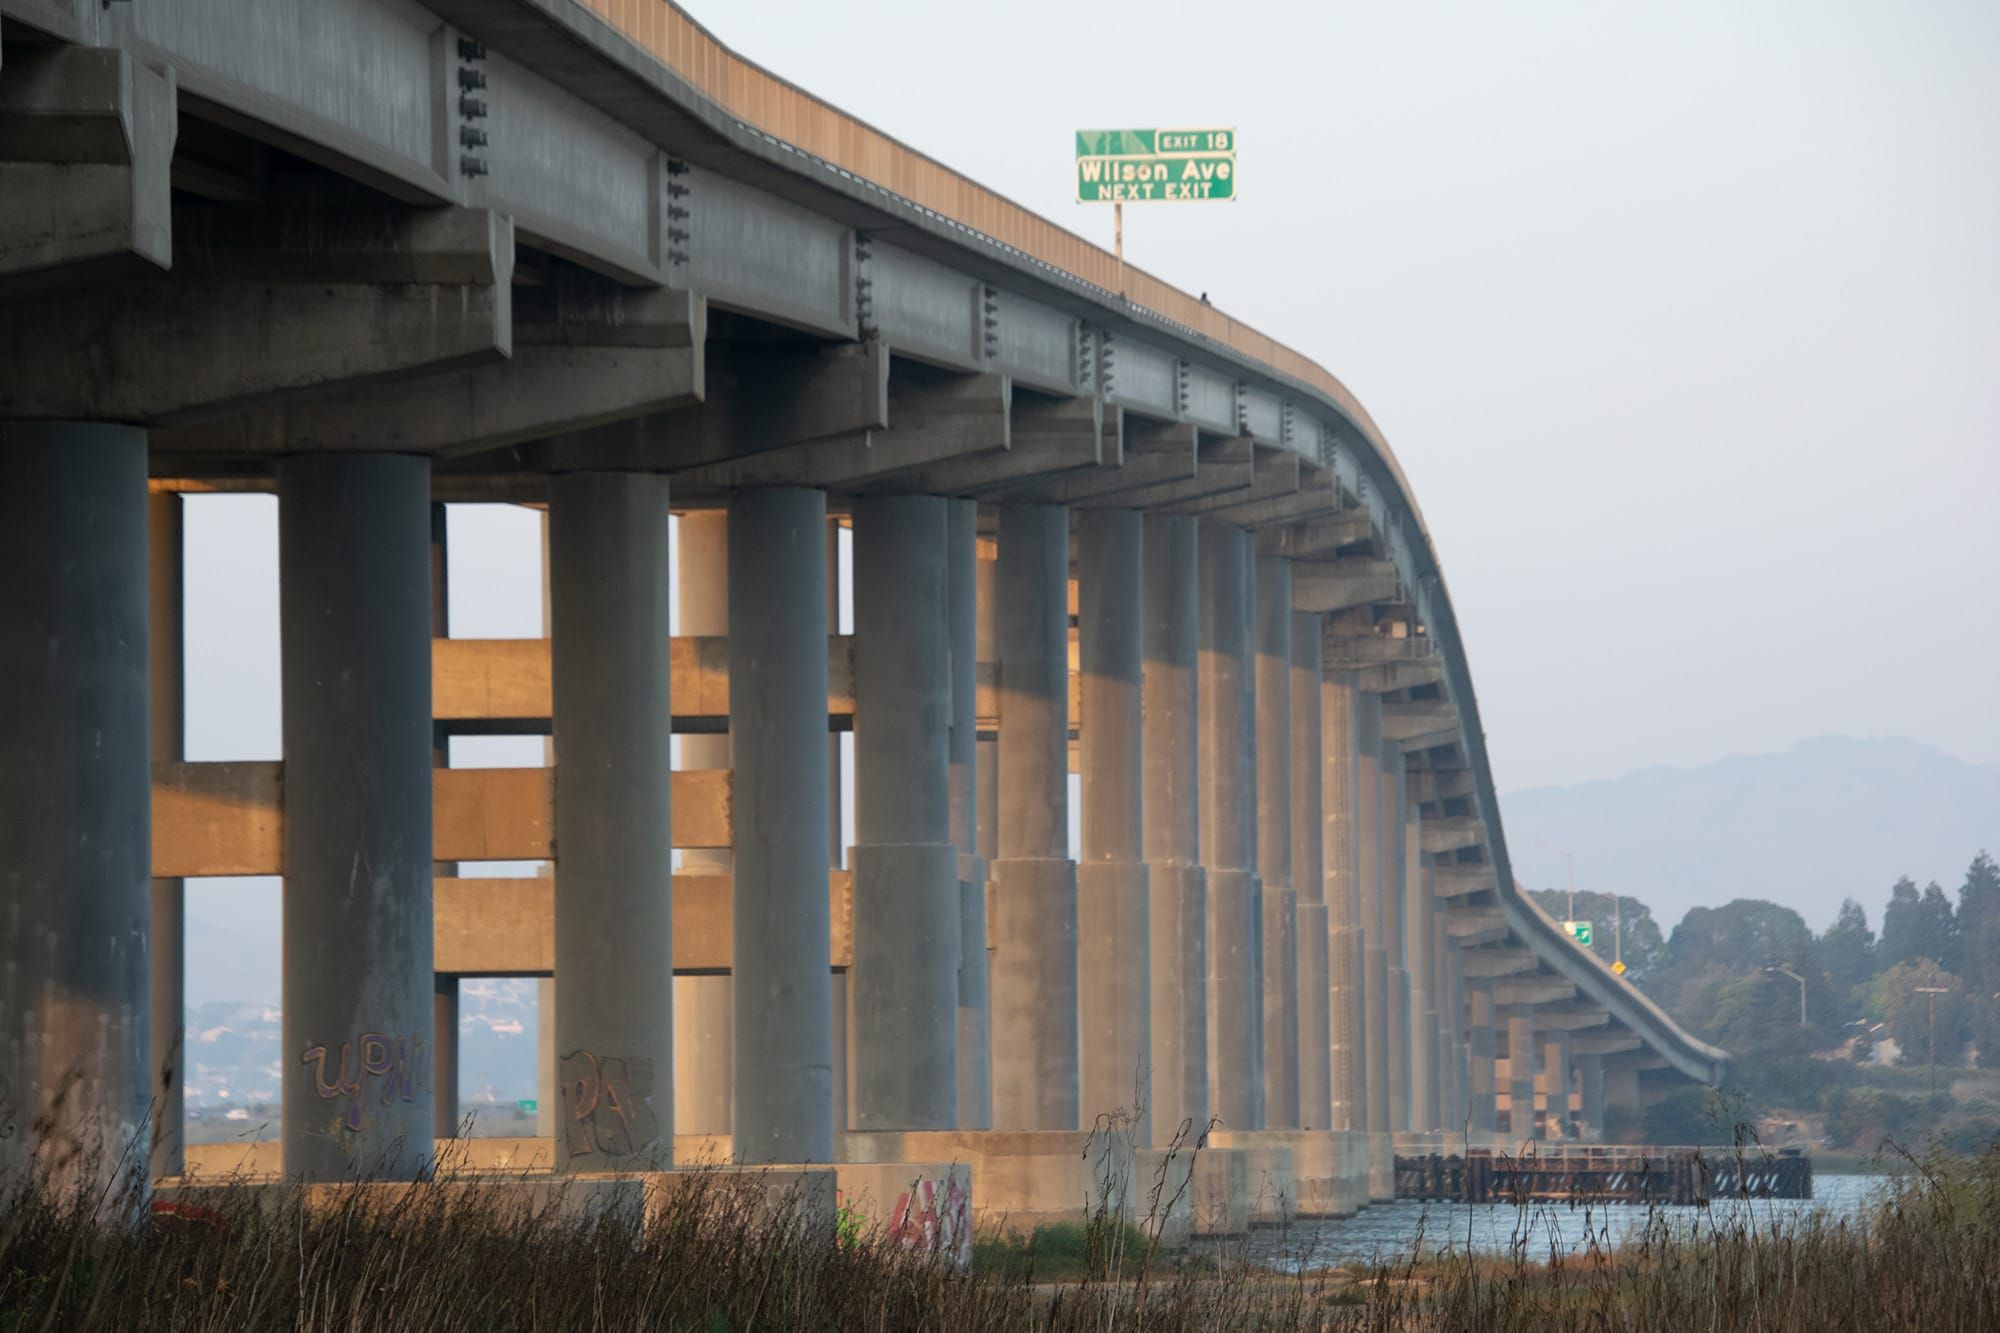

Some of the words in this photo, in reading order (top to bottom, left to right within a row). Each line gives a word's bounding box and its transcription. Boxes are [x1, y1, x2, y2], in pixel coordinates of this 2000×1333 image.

[1162, 135, 1198, 149] EXIT
[1081, 159, 1168, 182] Wilson
[1182, 159, 1230, 180] Ave
[1098, 183, 1154, 200] NEXT
[1165, 182, 1212, 199] EXIT
